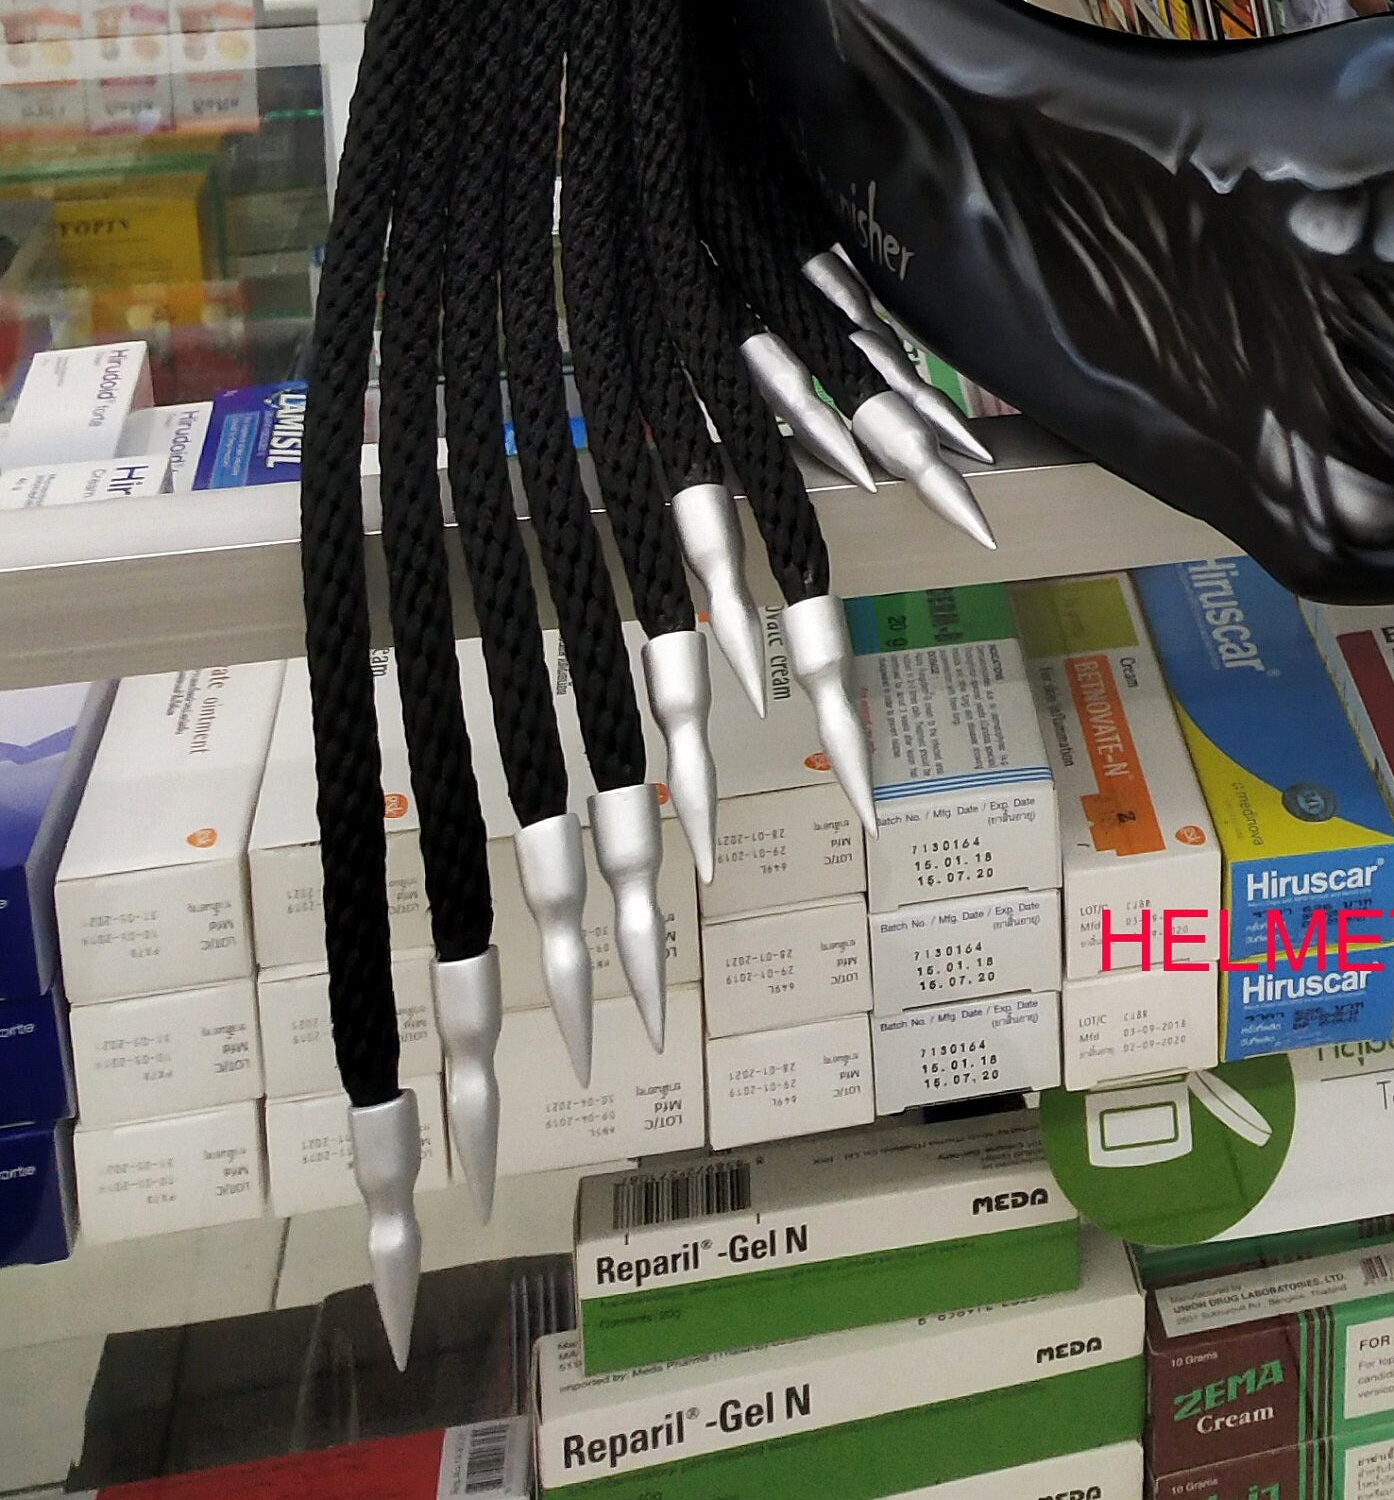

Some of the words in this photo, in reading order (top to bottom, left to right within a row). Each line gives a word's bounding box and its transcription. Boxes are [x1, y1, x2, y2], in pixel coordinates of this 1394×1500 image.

[841, 180, 915, 281] isher
[99, 349, 129, 401] Hirudoid
[266, 392, 308, 469] LAMISIL
[1188, 557, 1266, 673] Hiruscar
[770, 655, 791, 702] cream
[1120, 656, 1140, 688] Cream
[190, 696, 221, 754] ointment
[1074, 660, 1132, 778] BETNOVATE-N
[1246, 865, 1378, 902] Hiruscar
[1242, 970, 1373, 1005] Hiruscar
[1078, 1014, 1108, 1028] LOT/C
[972, 1187, 1049, 1217] MEDA
[784, 1224, 809, 1255] N
[1036, 1335, 1104, 1365] MEDA
[1358, 1332, 1391, 1352] FOR
[784, 1383, 812, 1419] N
[1172, 1358, 1285, 1423] ZEMA
[1195, 1404, 1275, 1436] Cream
